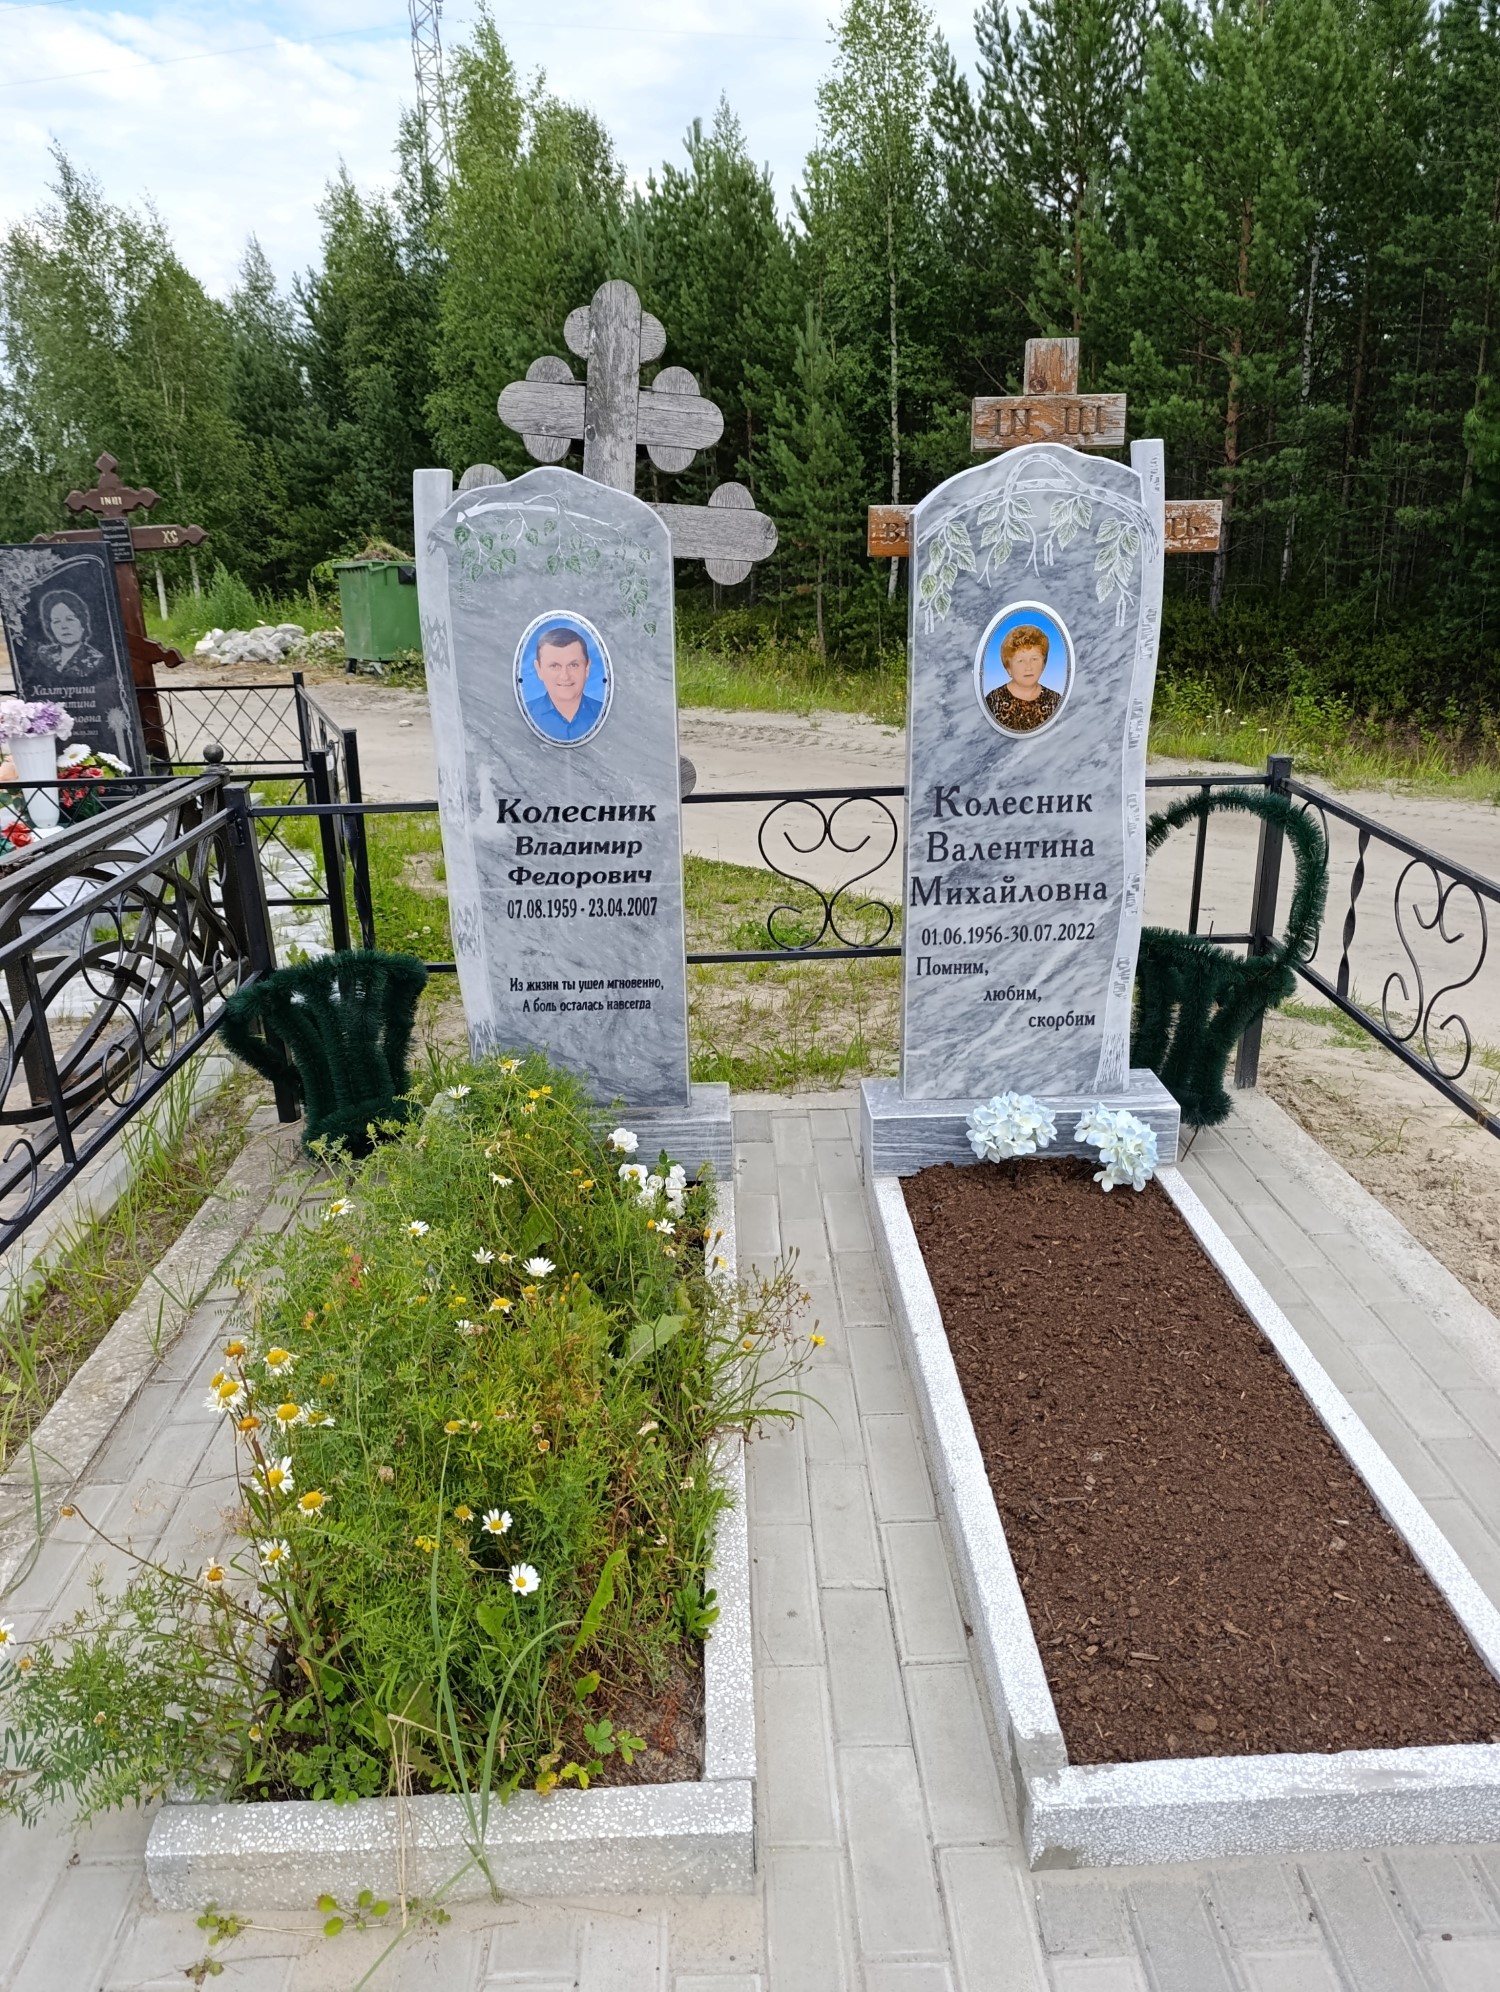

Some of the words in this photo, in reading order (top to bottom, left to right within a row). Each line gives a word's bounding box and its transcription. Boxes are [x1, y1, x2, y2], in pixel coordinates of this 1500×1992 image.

[30, 684, 96, 699] Халтурина
[496, 798, 657, 824] Колесник
[932, 785, 1094, 818] Колесник
[515, 835, 643, 858] Владимир
[926, 831, 1096, 863] Валентина
[508, 866, 652, 889] Федорович
[910, 875, 1109, 907] Михайловна
[507, 898, 577, 919] 07.08.1959
[588, 896, 658, 917] 23.04.2007
[921, 922, 1096, 946] 01.06.1956-30.07.2022
[916, 956, 990, 976] Помним,
[509, 977, 524, 992] Из
[526, 979, 559, 991] жизни
[561, 979, 576, 990] ты
[578, 979, 605, 993] ушел
[606, 977, 665, 990] мгновенно,
[983, 984, 1043, 1003] любим,
[522, 999, 531, 1013] А
[533, 997, 557, 1012] боль
[559, 1000, 605, 1012] осталась
[606, 999, 652, 1011] навсегда
[1027, 1010, 1097, 1031] скорбим
